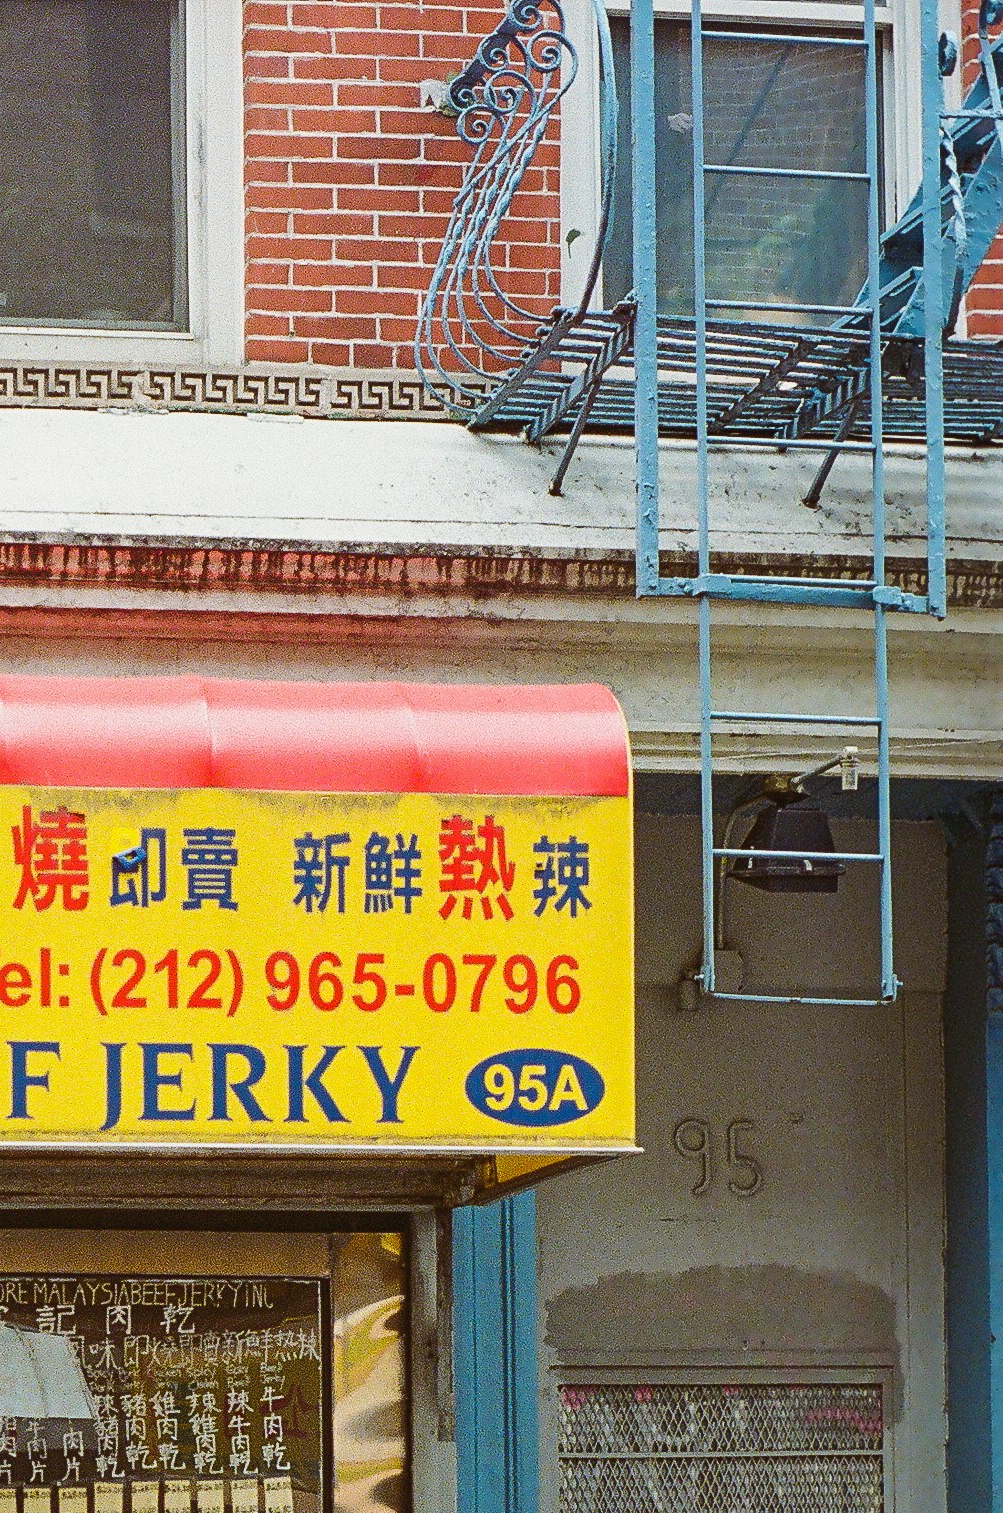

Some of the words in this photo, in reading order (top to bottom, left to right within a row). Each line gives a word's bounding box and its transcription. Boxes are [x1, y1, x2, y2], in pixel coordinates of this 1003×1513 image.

[293, 815, 592, 921] 新鮮熱辣
[90, 946, 244, 1016] (212)
[265, 950, 581, 1014] 965-0796
[101, 1042, 419, 1132] JERKY
[483, 1063, 588, 1114] 95A
[674, 1117, 764, 1197] 95
[260, 1386, 292, 1471] 牛肉乾
